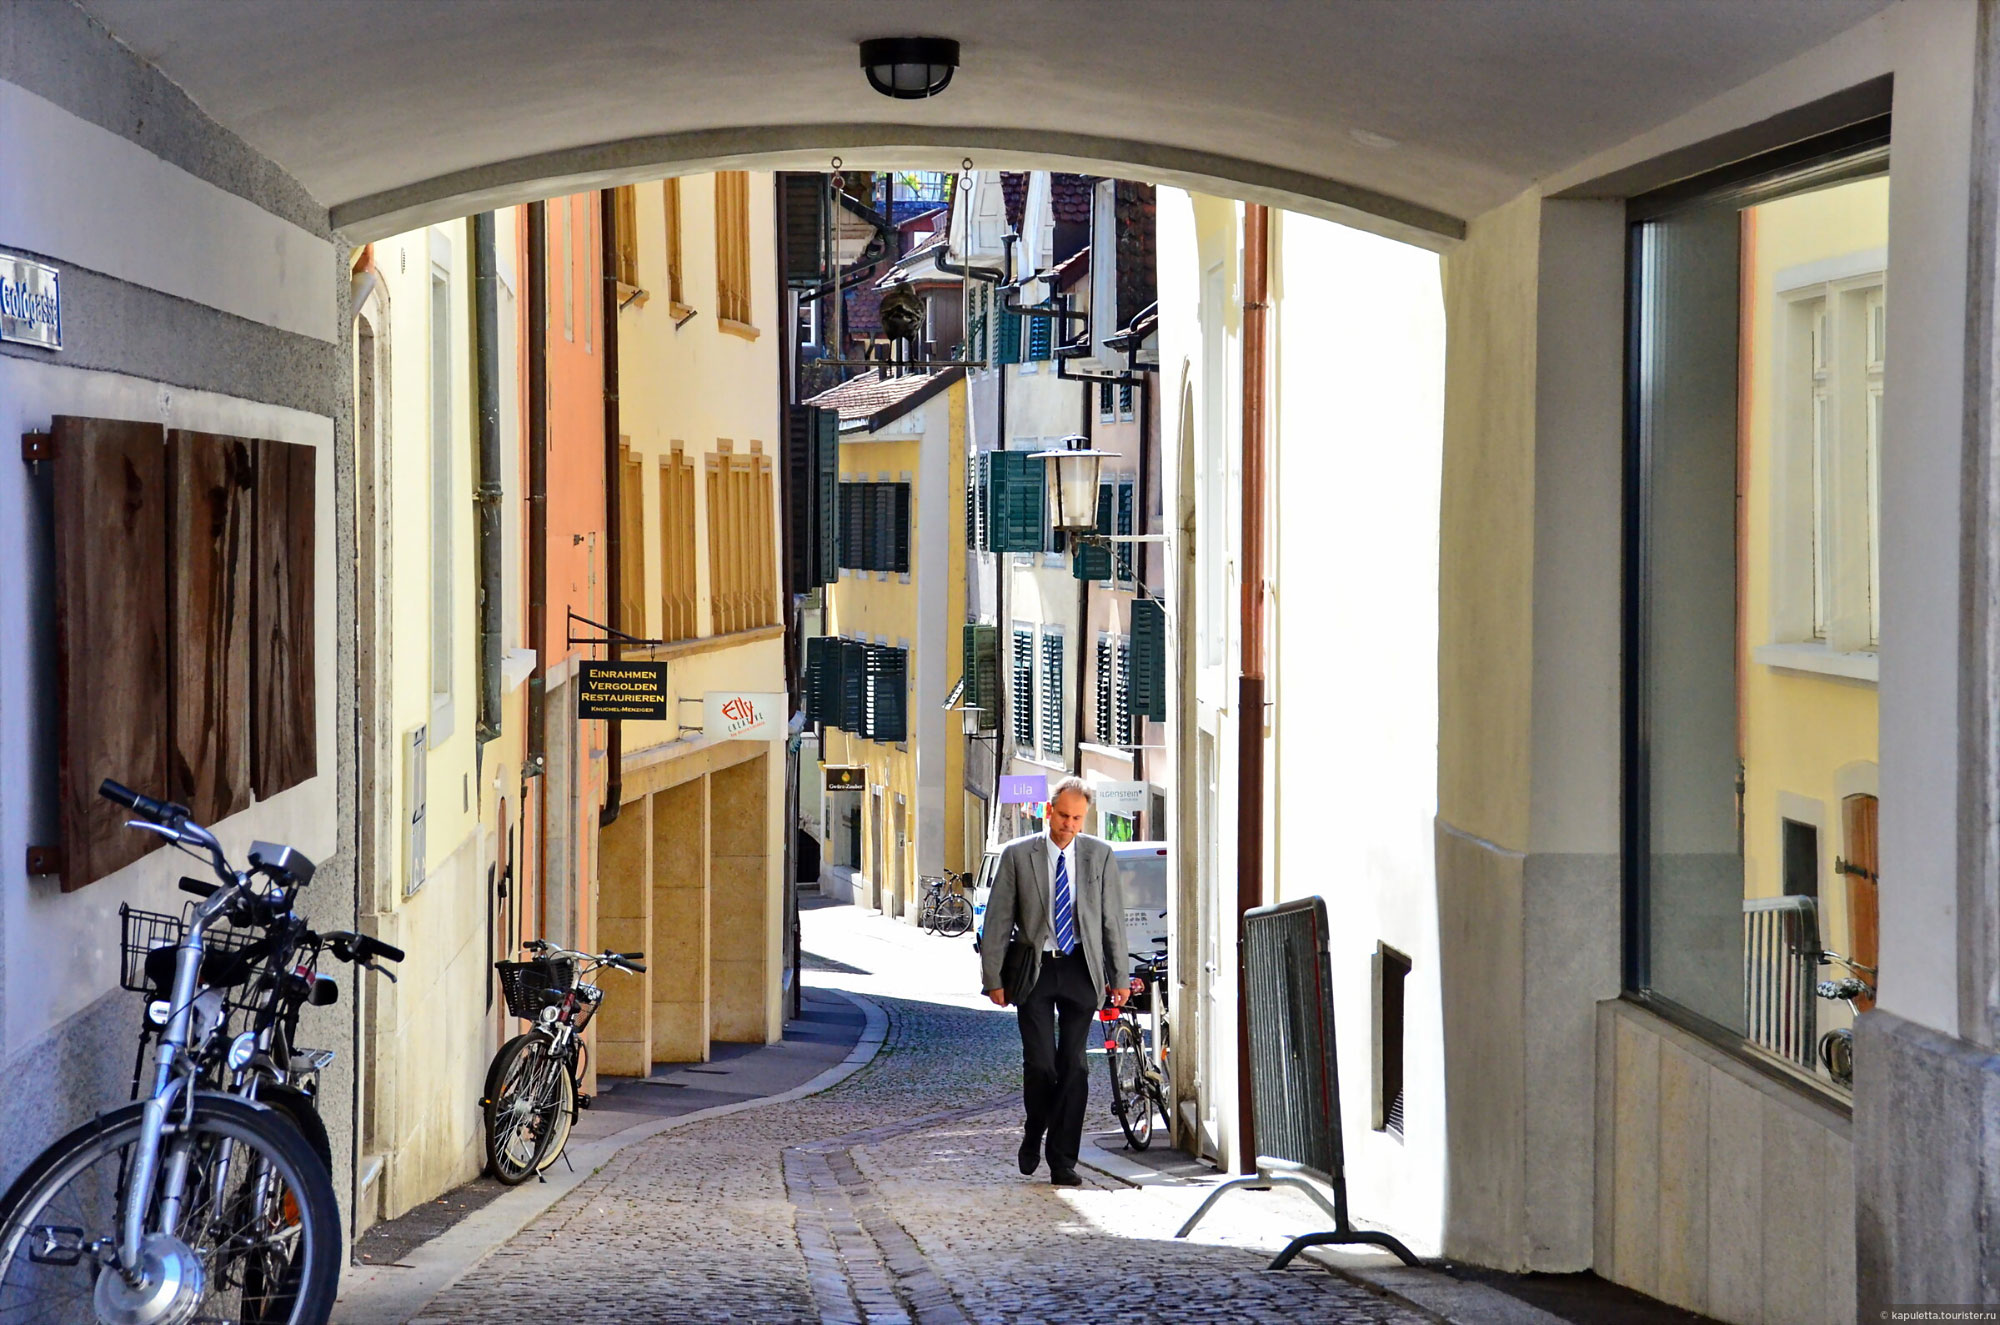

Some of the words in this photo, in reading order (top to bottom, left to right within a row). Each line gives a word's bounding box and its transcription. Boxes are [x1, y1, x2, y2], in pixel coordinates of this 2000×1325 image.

[589, 668, 657, 679] EINRAHMEN
[588, 681, 658, 691] VERGOLDEN
[581, 692, 665, 703] RESTAURIEREN
[721, 697, 754, 724] Elly
[1013, 783, 1033, 796] Lila
